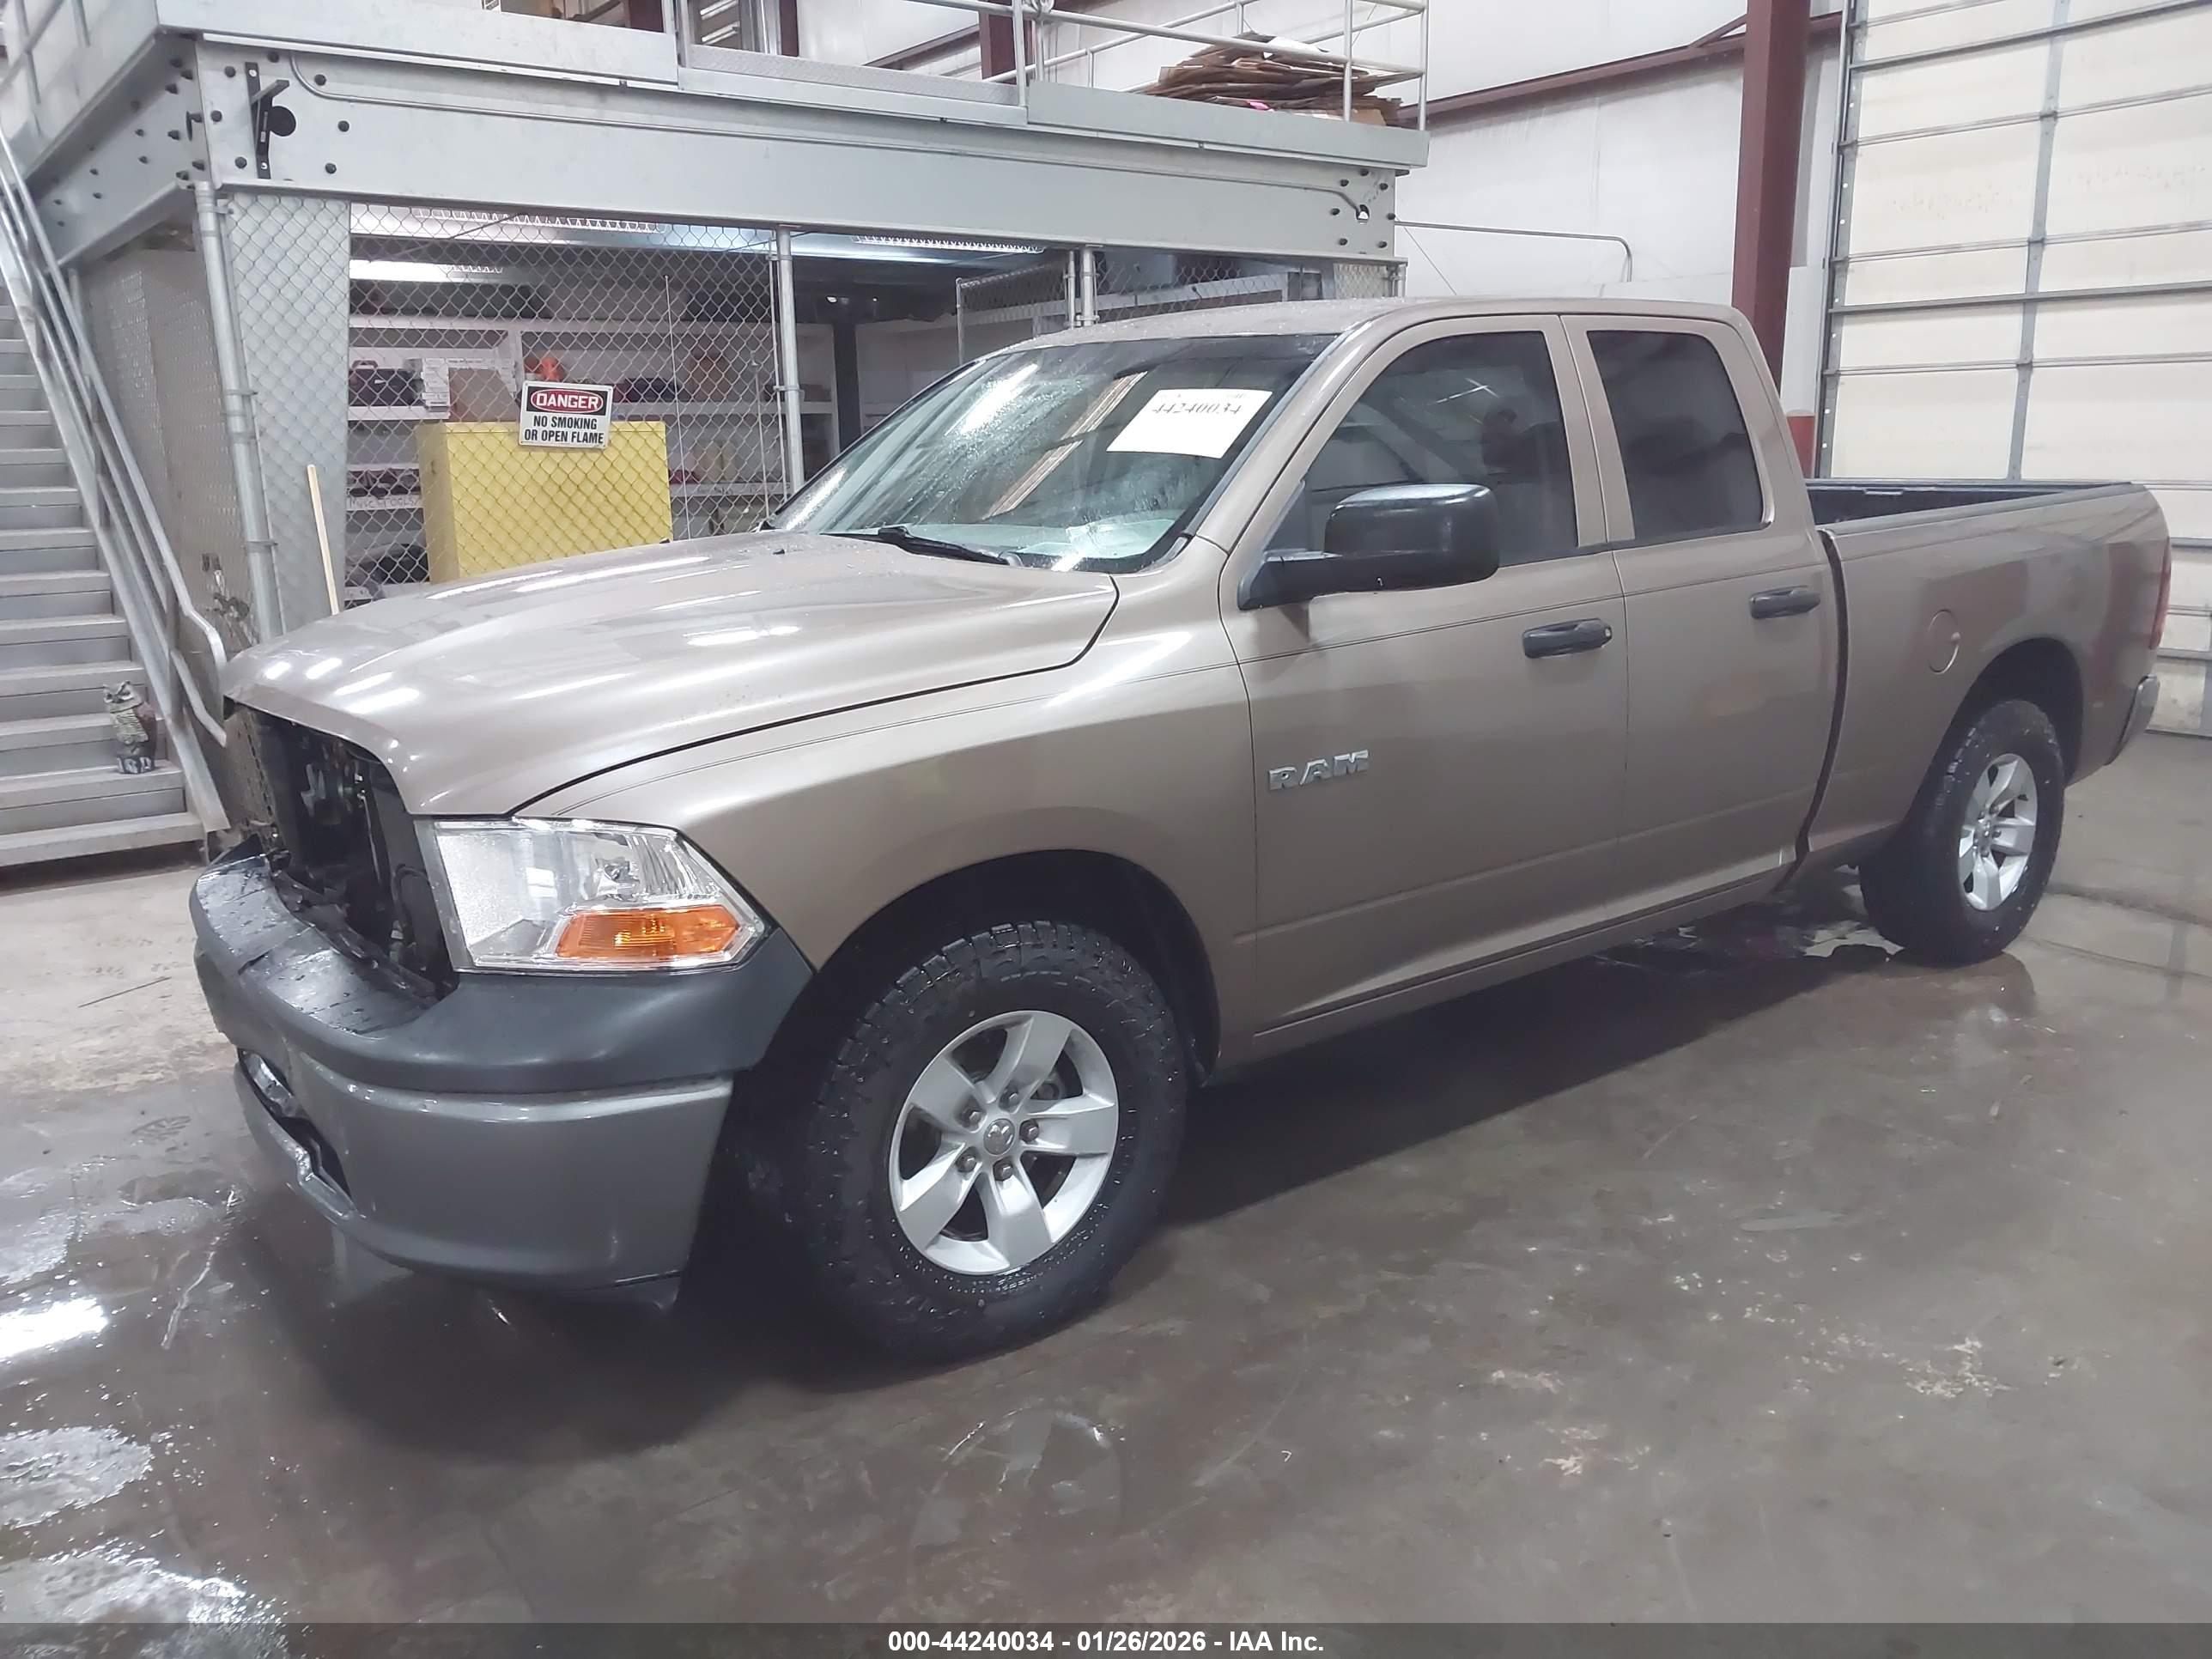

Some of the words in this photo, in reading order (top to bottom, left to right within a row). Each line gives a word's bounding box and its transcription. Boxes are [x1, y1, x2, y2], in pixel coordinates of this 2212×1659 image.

[536, 392, 599, 410] DANGER
[533, 415, 548, 428] NO
[551, 416, 598, 430] SMOKING
[524, 428, 538, 441] OR
[542, 429, 568, 443] OPEN
[571, 431, 604, 444] FLAME
[1268, 749, 1370, 791] RAM
